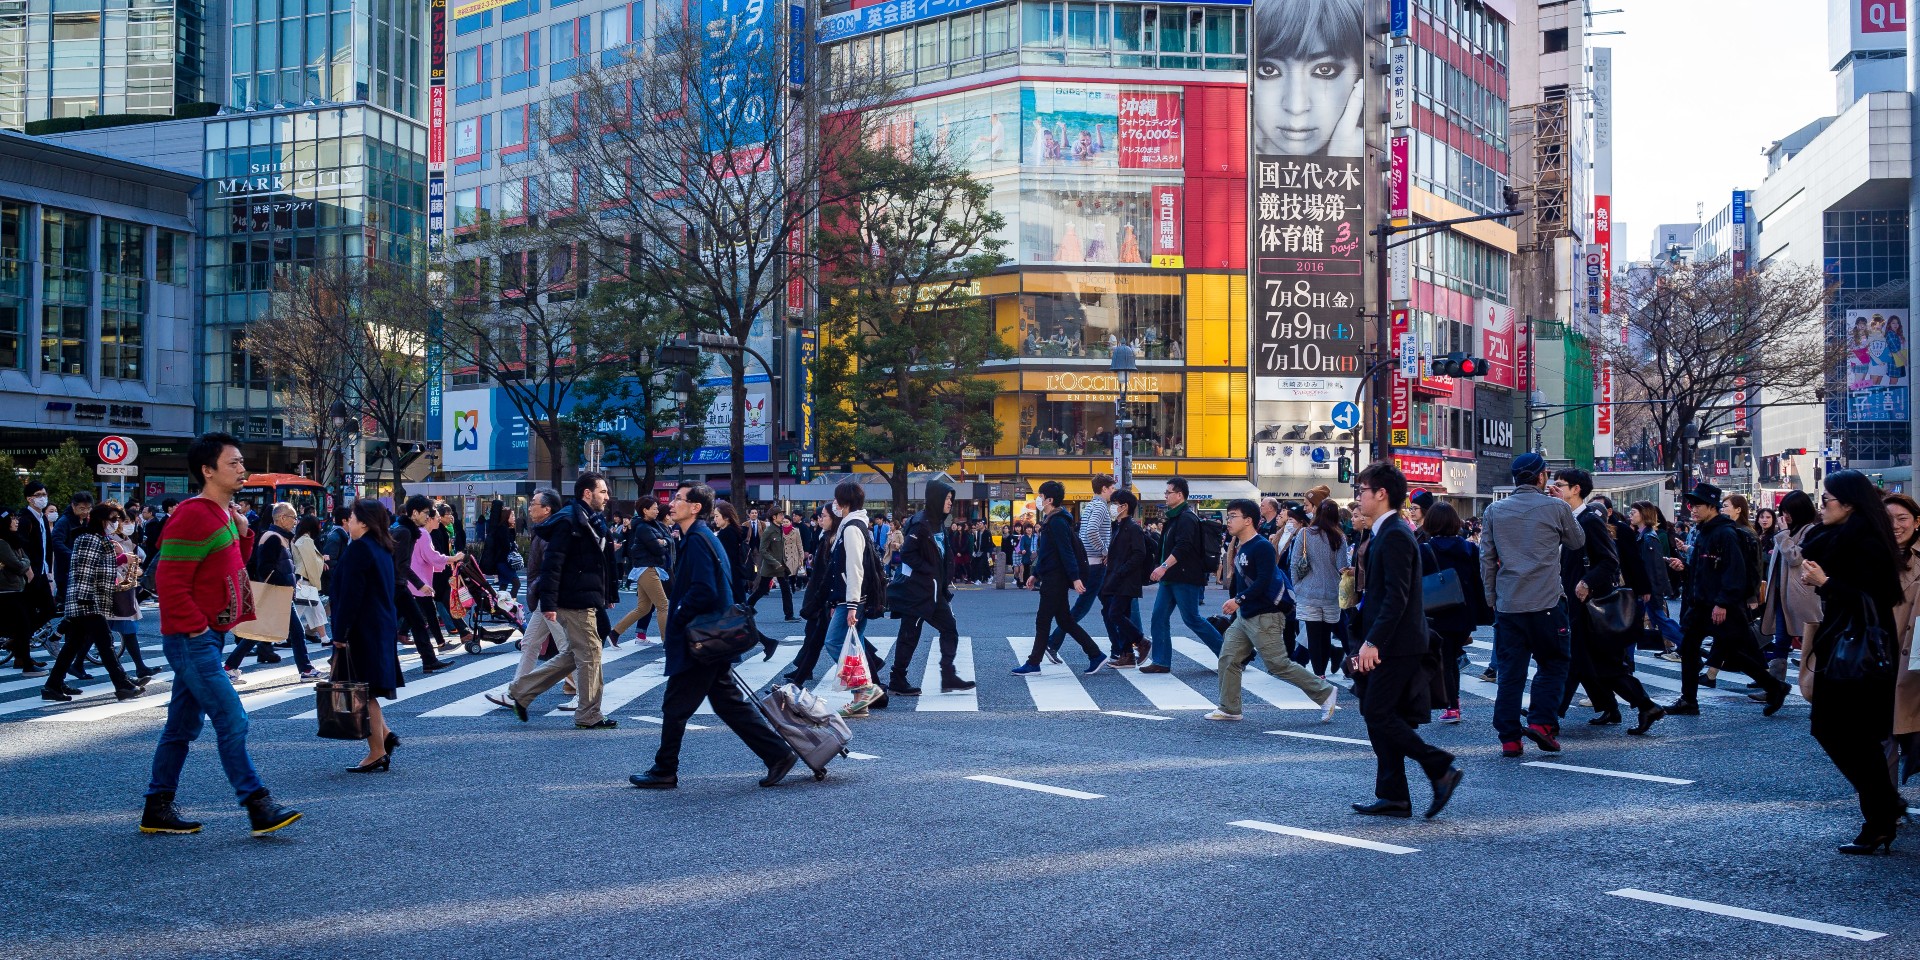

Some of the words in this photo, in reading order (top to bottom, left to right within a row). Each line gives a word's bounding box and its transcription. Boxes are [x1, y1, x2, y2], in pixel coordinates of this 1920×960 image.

[432, 69, 444, 77] 8F
[1395, 54, 1404, 120] 渋谷駅前ビル
[433, 88, 443, 128] 外貨両替
[1120, 98, 1157, 116] 沖縄
[1392, 138, 1407, 147] 5F
[252, 159, 316, 174] SHIBUYA
[1259, 161, 1360, 190] 国立代々木
[218, 176, 286, 193] MARK
[298, 170, 356, 187] CITY
[253, 204, 270, 214] 渋谷
[273, 202, 313, 212] マークシティ
[1258, 193, 1361, 221] 競技場第一
[1160, 192, 1174, 248] 毎日開催
[1597, 208, 1608, 231] 免税
[1259, 223, 1325, 252] 体育館
[1335, 222, 1351, 243] 3
[1330, 237, 1359, 257] Days!
[1297, 261, 1324, 272] 2016
[1265, 280, 1354, 308] 7月8日(金)
[1265, 311, 1354, 340] 7月9日(土)
[1261, 343, 1359, 372] 7月10日(日)
[1488, 335, 1509, 360] アコム
[712, 402, 733, 412] ハチ公
[237, 425, 260, 433] MRK
[1393, 430, 1406, 444] 薬
[1483, 418, 1513, 448] LUSH
[100, 466, 125, 474] ここまで
